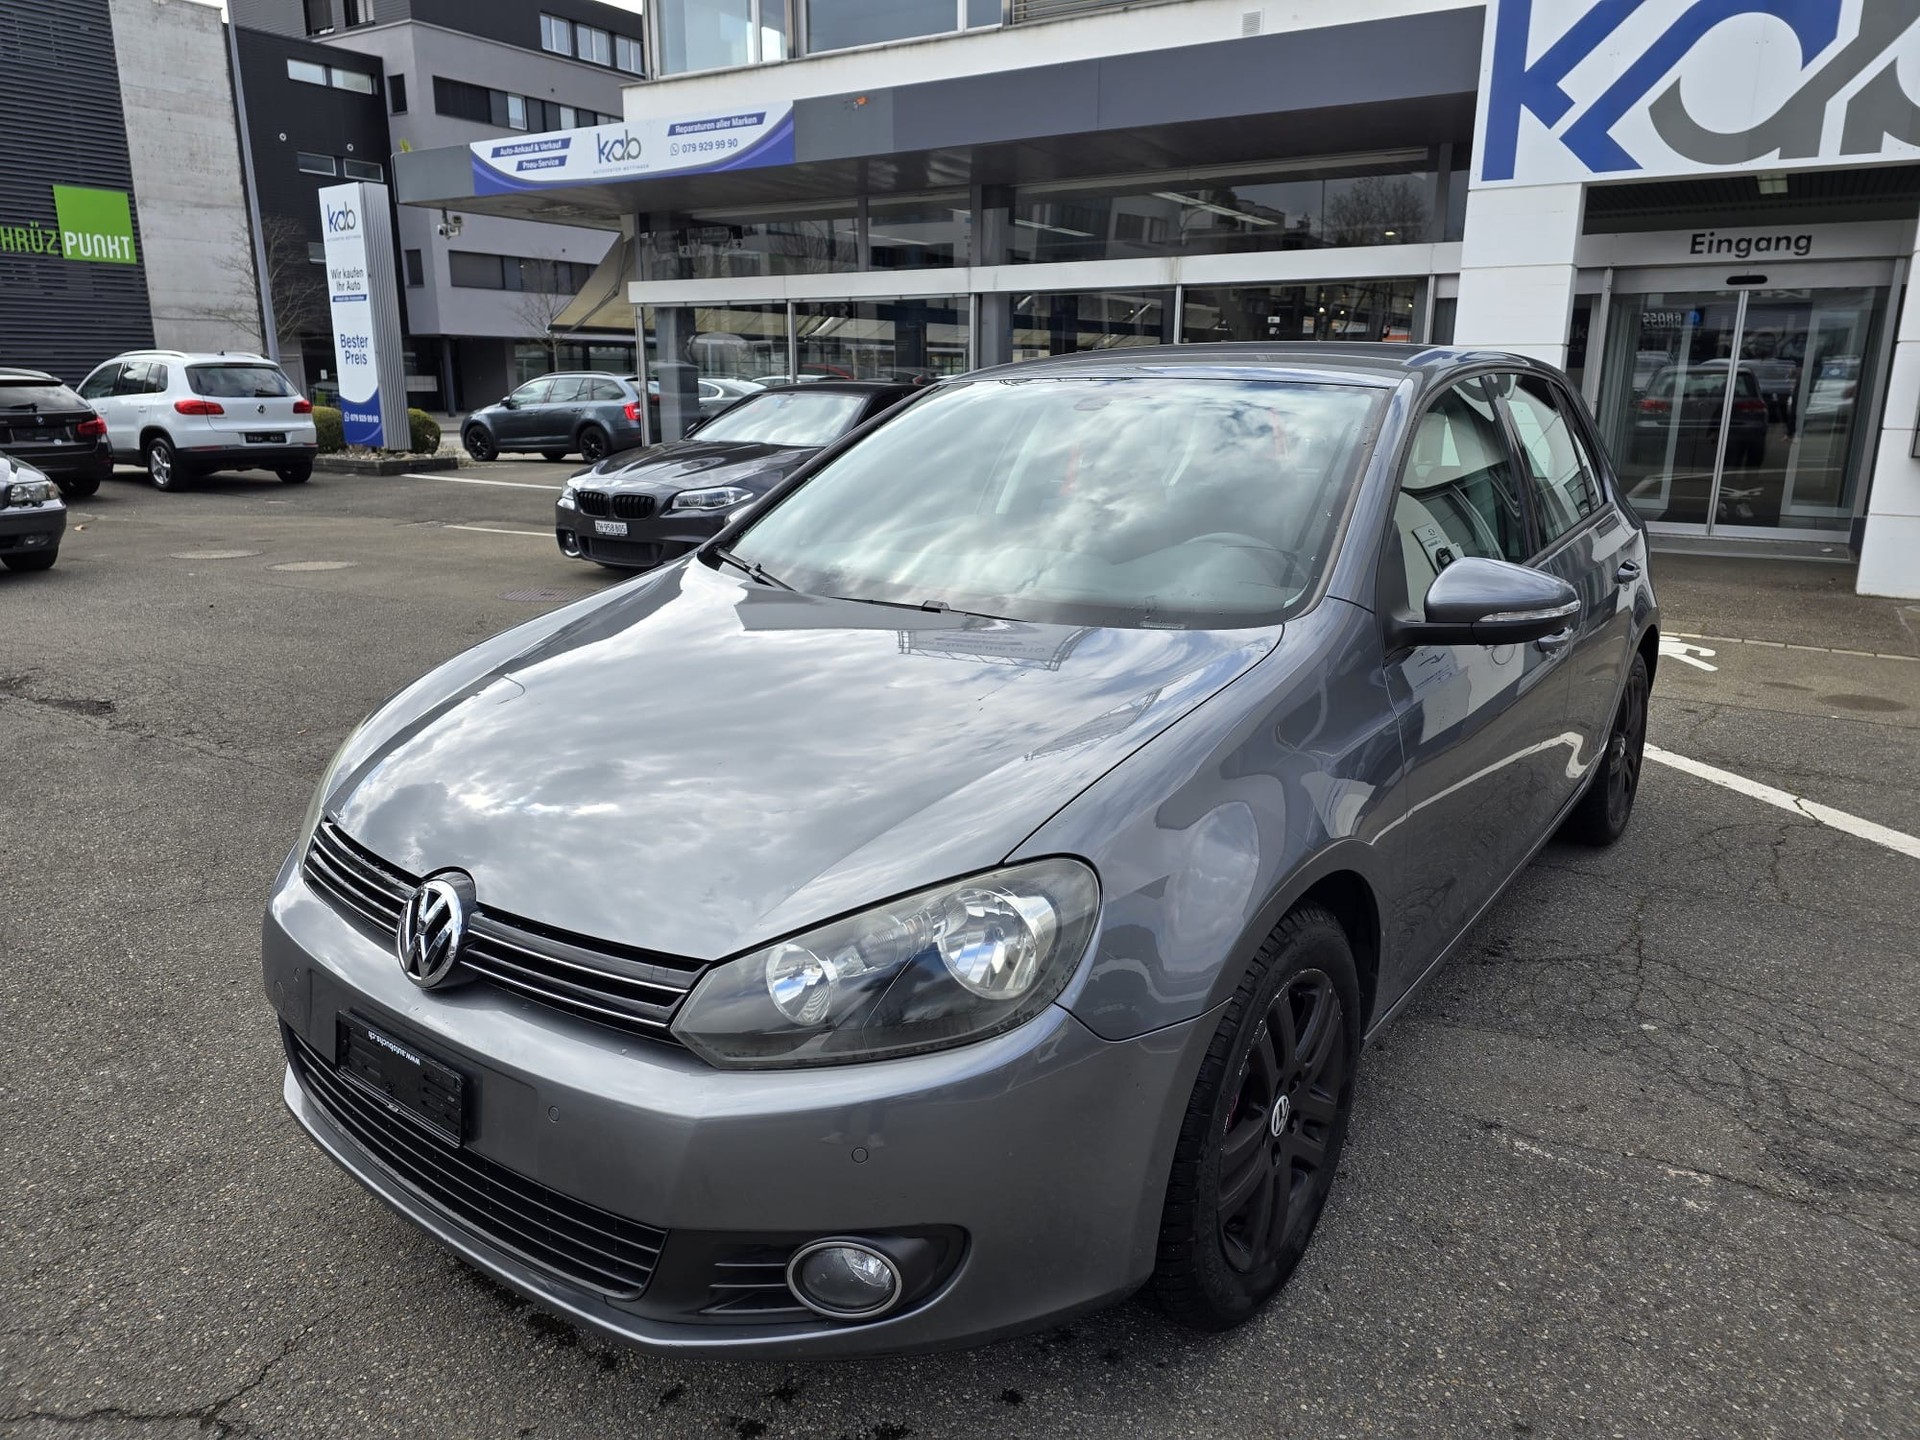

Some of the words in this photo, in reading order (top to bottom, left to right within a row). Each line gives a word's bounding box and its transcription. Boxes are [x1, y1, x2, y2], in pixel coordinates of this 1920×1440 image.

[675, 122, 715, 134] Reparaturen
[716, 118, 731, 129] aller
[732, 116, 757, 127] Marken
[597, 129, 641, 164] kab
[682, 143, 696, 153] 079
[699, 141, 713, 151] 929
[715, 139, 725, 149] 99
[728, 138, 738, 148] 90
[522, 159, 559, 169] Pneu-Service
[327, 201, 356, 233] kab
[64, 231, 131, 260] PUNKT
[1690, 231, 1813, 258] Eingang
[330, 269, 341, 280] Wir
[343, 267, 364, 279] kaufen
[336, 281, 345, 292] Ihr
[346, 280, 361, 291] Auto
[340, 333, 368, 349] Bester
[345, 349, 368, 365] Preis
